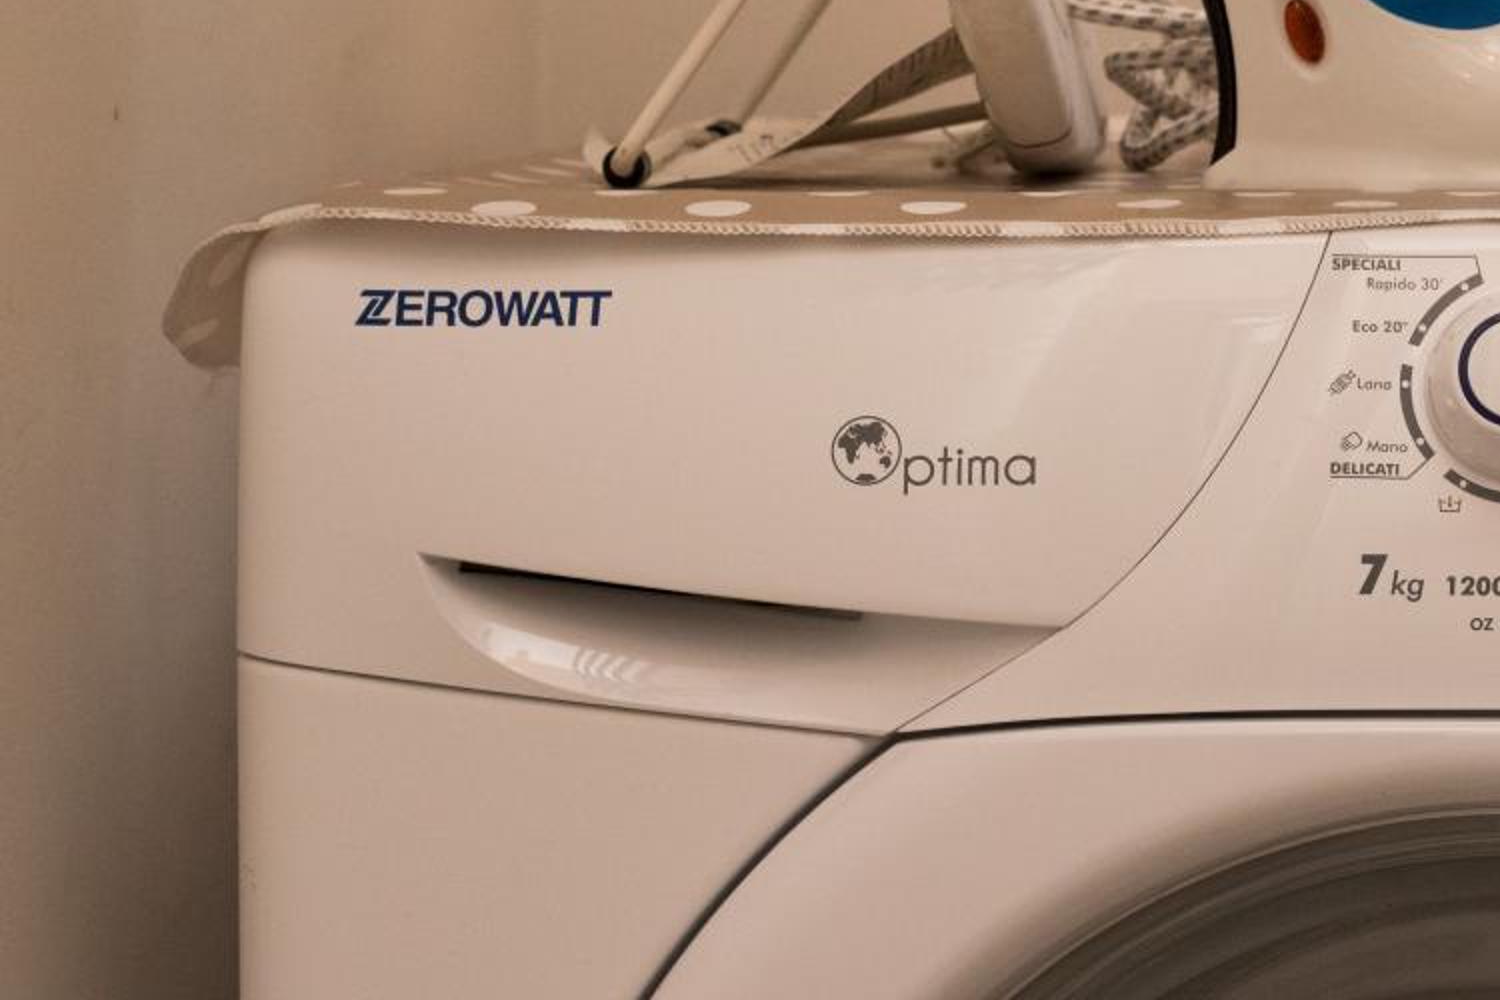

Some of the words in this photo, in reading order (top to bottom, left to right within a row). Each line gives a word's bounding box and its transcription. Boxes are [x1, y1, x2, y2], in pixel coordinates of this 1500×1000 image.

[1331, 258, 1401, 271] SPECIALI
[1366, 277, 1417, 292] Rapido
[355, 289, 613, 327] ZEROWATT
[1352, 319, 1378, 333] Eco
[1356, 377, 1392, 391] Lana
[1366, 440, 1409, 453] Mano
[1329, 462, 1401, 476] DELICATI
[1359, 553, 1388, 595] 7
[1390, 569, 1425, 601] kg
[1469, 617, 1495, 632] OZ
